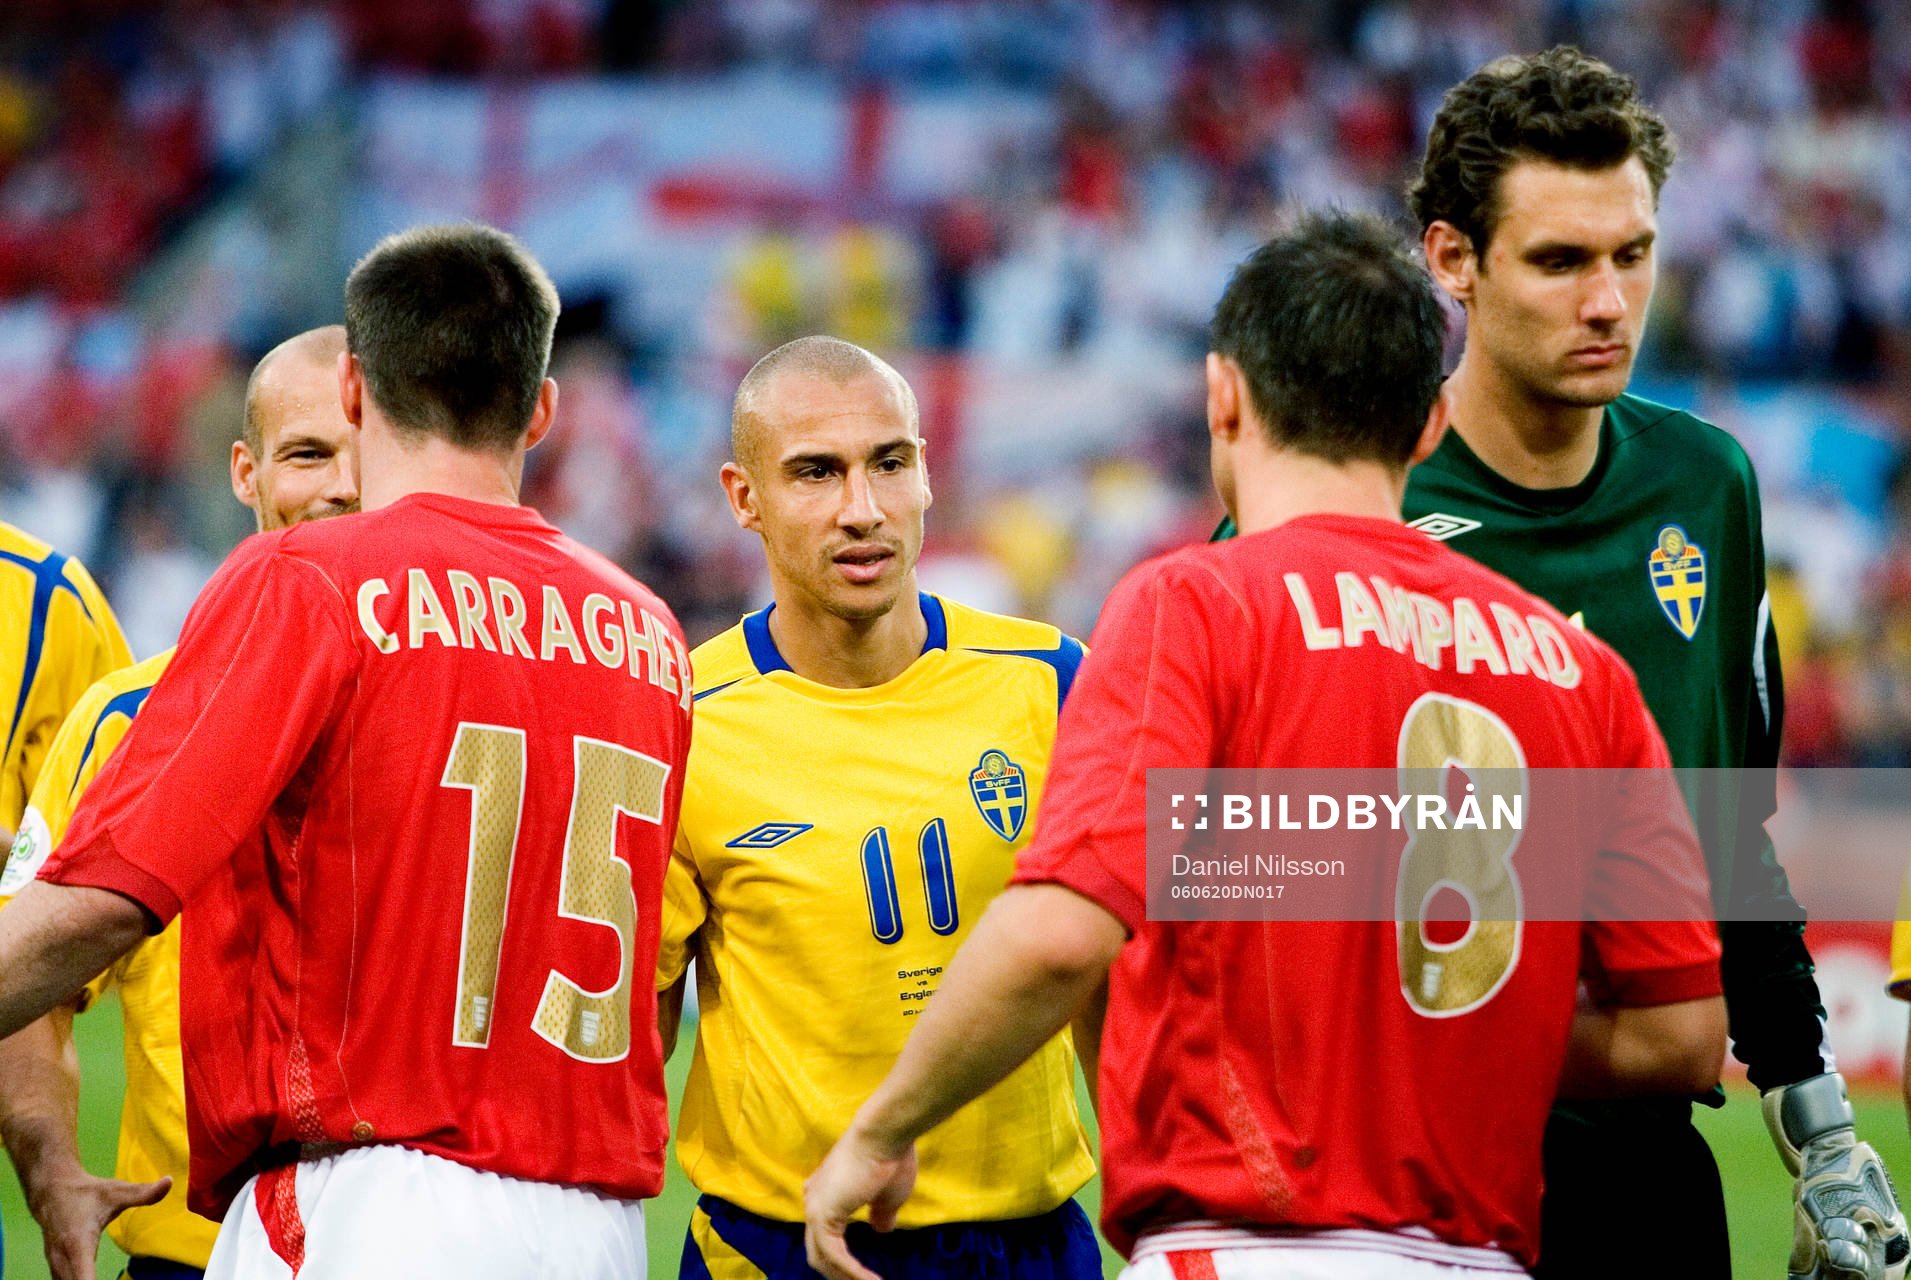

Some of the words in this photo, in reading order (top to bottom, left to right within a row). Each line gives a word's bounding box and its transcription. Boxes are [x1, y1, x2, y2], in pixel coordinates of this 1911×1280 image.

[1283, 572, 1581, 690] LAMPARD
[986, 778, 1011, 788] SvFF
[440, 721, 672, 1064] 15
[860, 817, 959, 945] 11
[1395, 691, 1529, 1018] 8
[897, 966, 943, 979] Sverige
